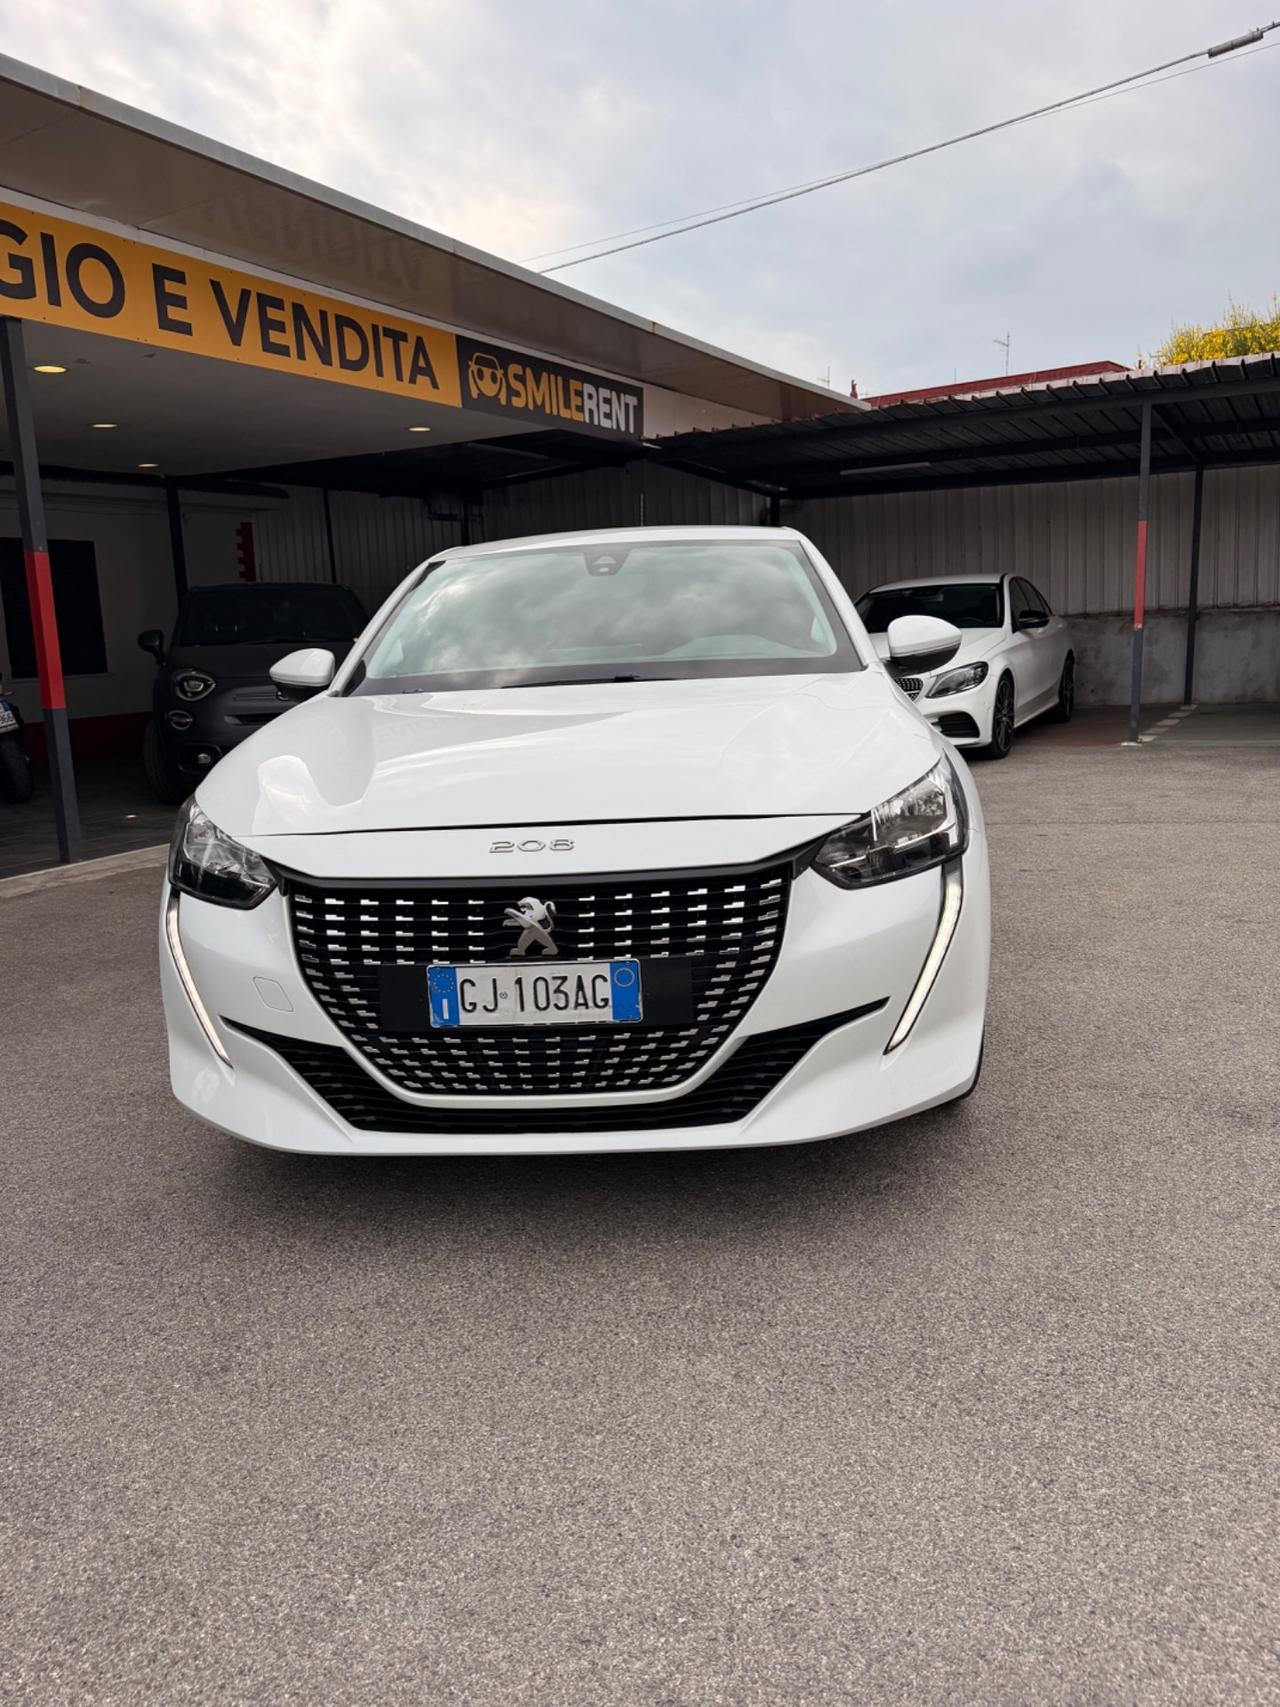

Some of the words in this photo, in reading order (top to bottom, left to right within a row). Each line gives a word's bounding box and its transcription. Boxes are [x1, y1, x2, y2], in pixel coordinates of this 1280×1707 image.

[152, 263, 193, 336] E
[209, 278, 440, 390] VENDITA
[489, 838, 575, 853] 208
